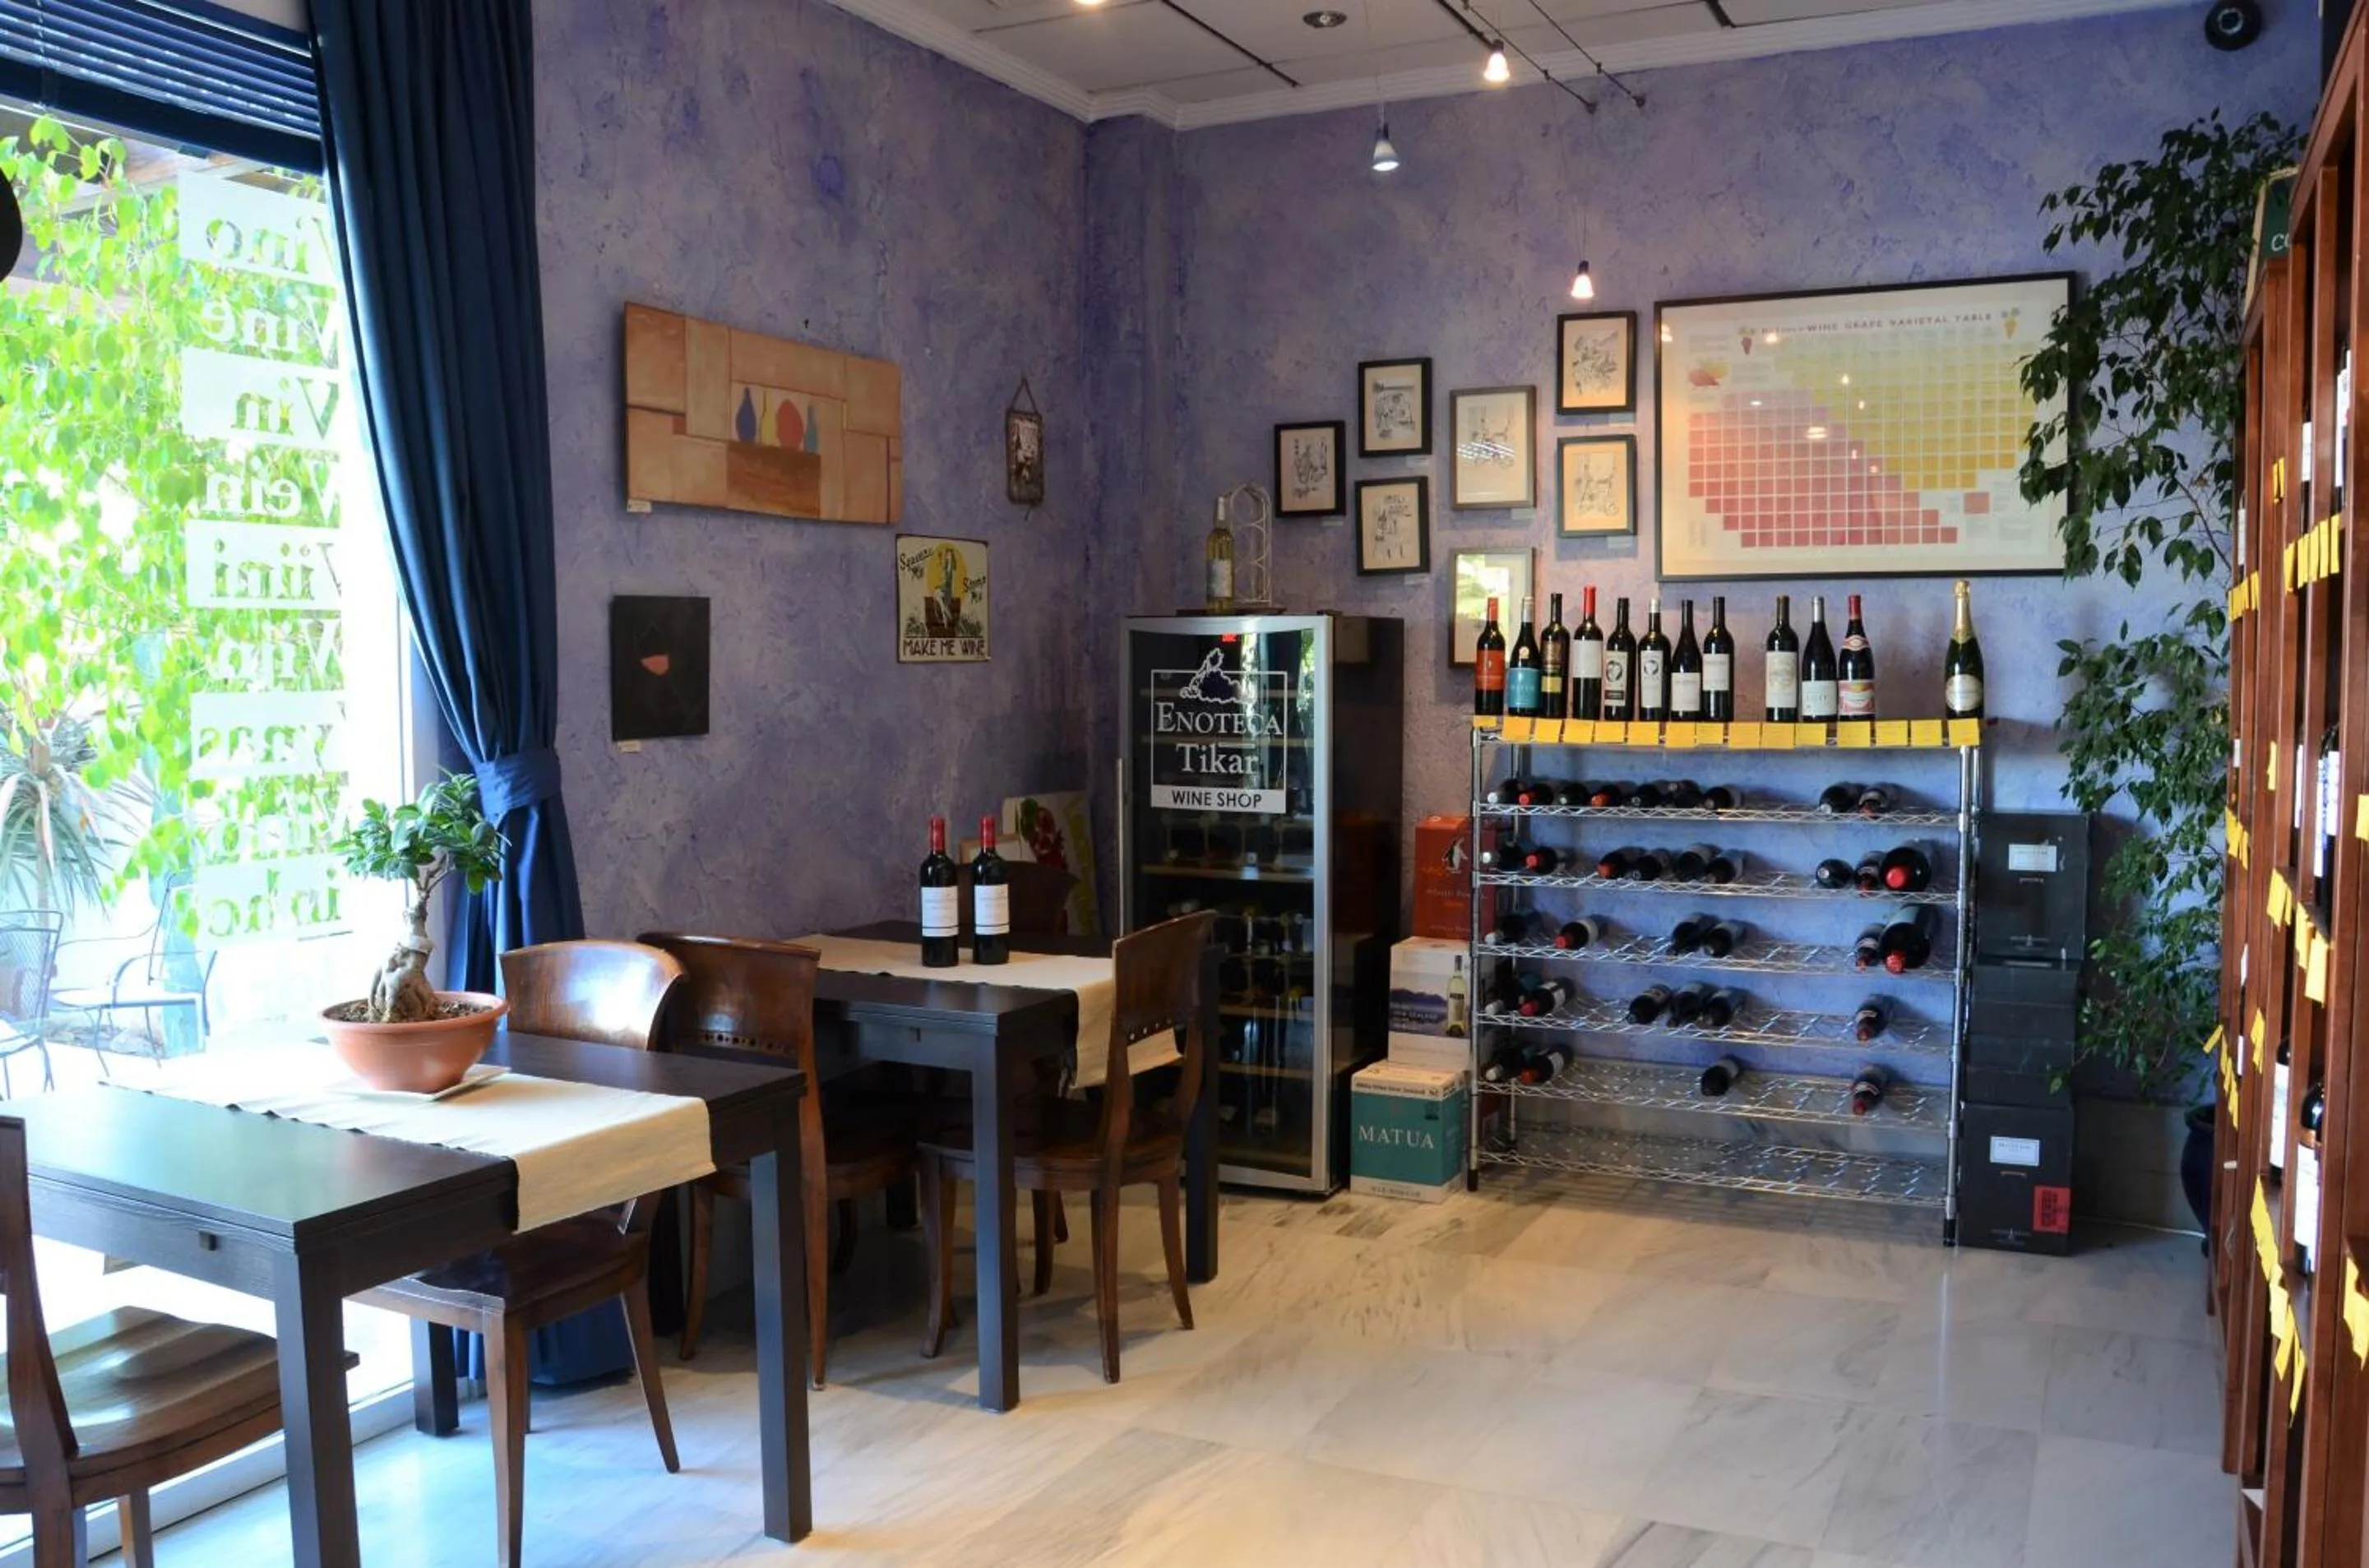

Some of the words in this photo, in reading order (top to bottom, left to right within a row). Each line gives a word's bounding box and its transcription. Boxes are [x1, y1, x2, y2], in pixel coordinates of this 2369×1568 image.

[903, 640, 937, 655] MAKE
[941, 640, 955, 655] ME
[960, 639, 984, 657] WINE
[1155, 701, 1283, 736] ENOTECA
[1175, 742, 1259, 775] Tikar
[1172, 789, 1212, 807] WINE
[1218, 793, 1262, 808] SHOP
[1358, 1125, 1434, 1149] MATUA
